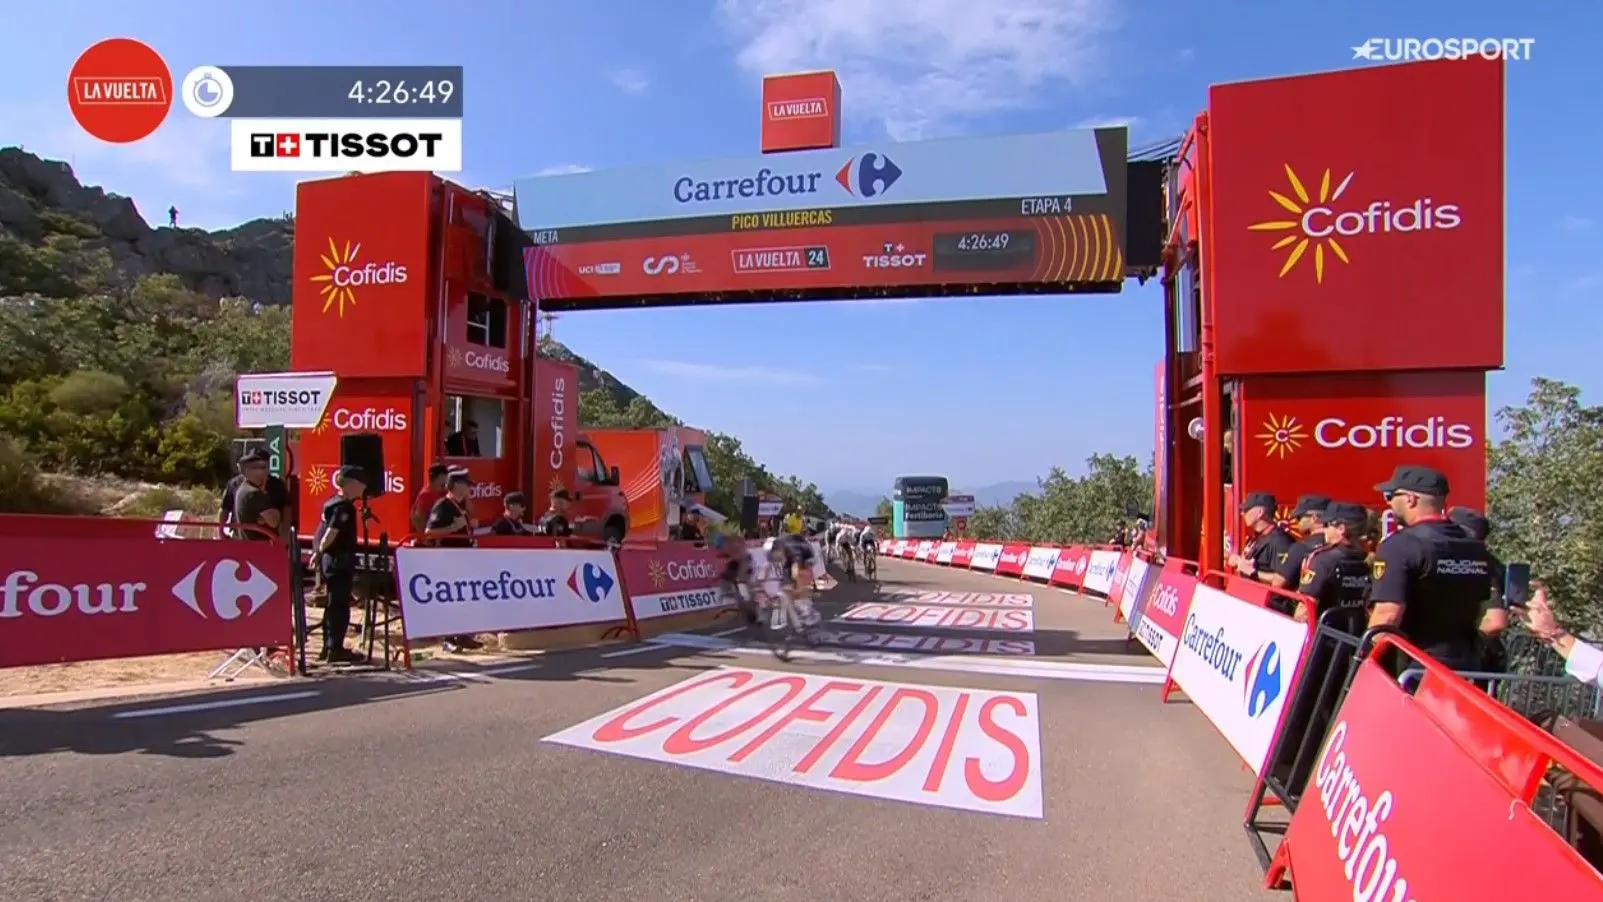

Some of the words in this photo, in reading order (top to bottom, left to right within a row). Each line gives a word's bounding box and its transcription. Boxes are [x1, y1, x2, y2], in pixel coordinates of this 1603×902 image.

[774, 103, 786, 117] LA
[787, 102, 822, 116] VUELTA
[674, 169, 821, 203] Carrefour
[1021, 199, 1061, 216] ETAPA
[1063, 198, 1072, 213] 4
[1302, 198, 1461, 237] Cofidis
[732, 212, 759, 230] PICO
[762, 209, 833, 228] VILLUERCAS
[533, 231, 559, 245] META
[958, 233, 1009, 250] 4:26:49
[739, 255, 751, 269] LA
[751, 252, 801, 268] VUELTA
[808, 251, 824, 265] 24
[863, 253, 926, 268] TISSOT
[334, 261, 407, 287] Cofidis
[465, 351, 510, 373] Cofidis
[263, 391, 321, 405] TISSOT
[333, 408, 407, 431] Cofidis
[550, 377, 565, 470] Cofidis
[1314, 416, 1473, 449] Cofidis
[468, 481, 502, 499] ofidis
[408, 570, 556, 604] Carrefour
[677, 591, 717, 609] TISSOT
[844, 605, 1029, 632] COFIDIS
[836, 633, 1032, 655] OFIDIS
[1183, 612, 1243, 683] Carrefour
[592, 670, 1031, 803] COFIDIS
[1315, 720, 1417, 902] Carrefou
